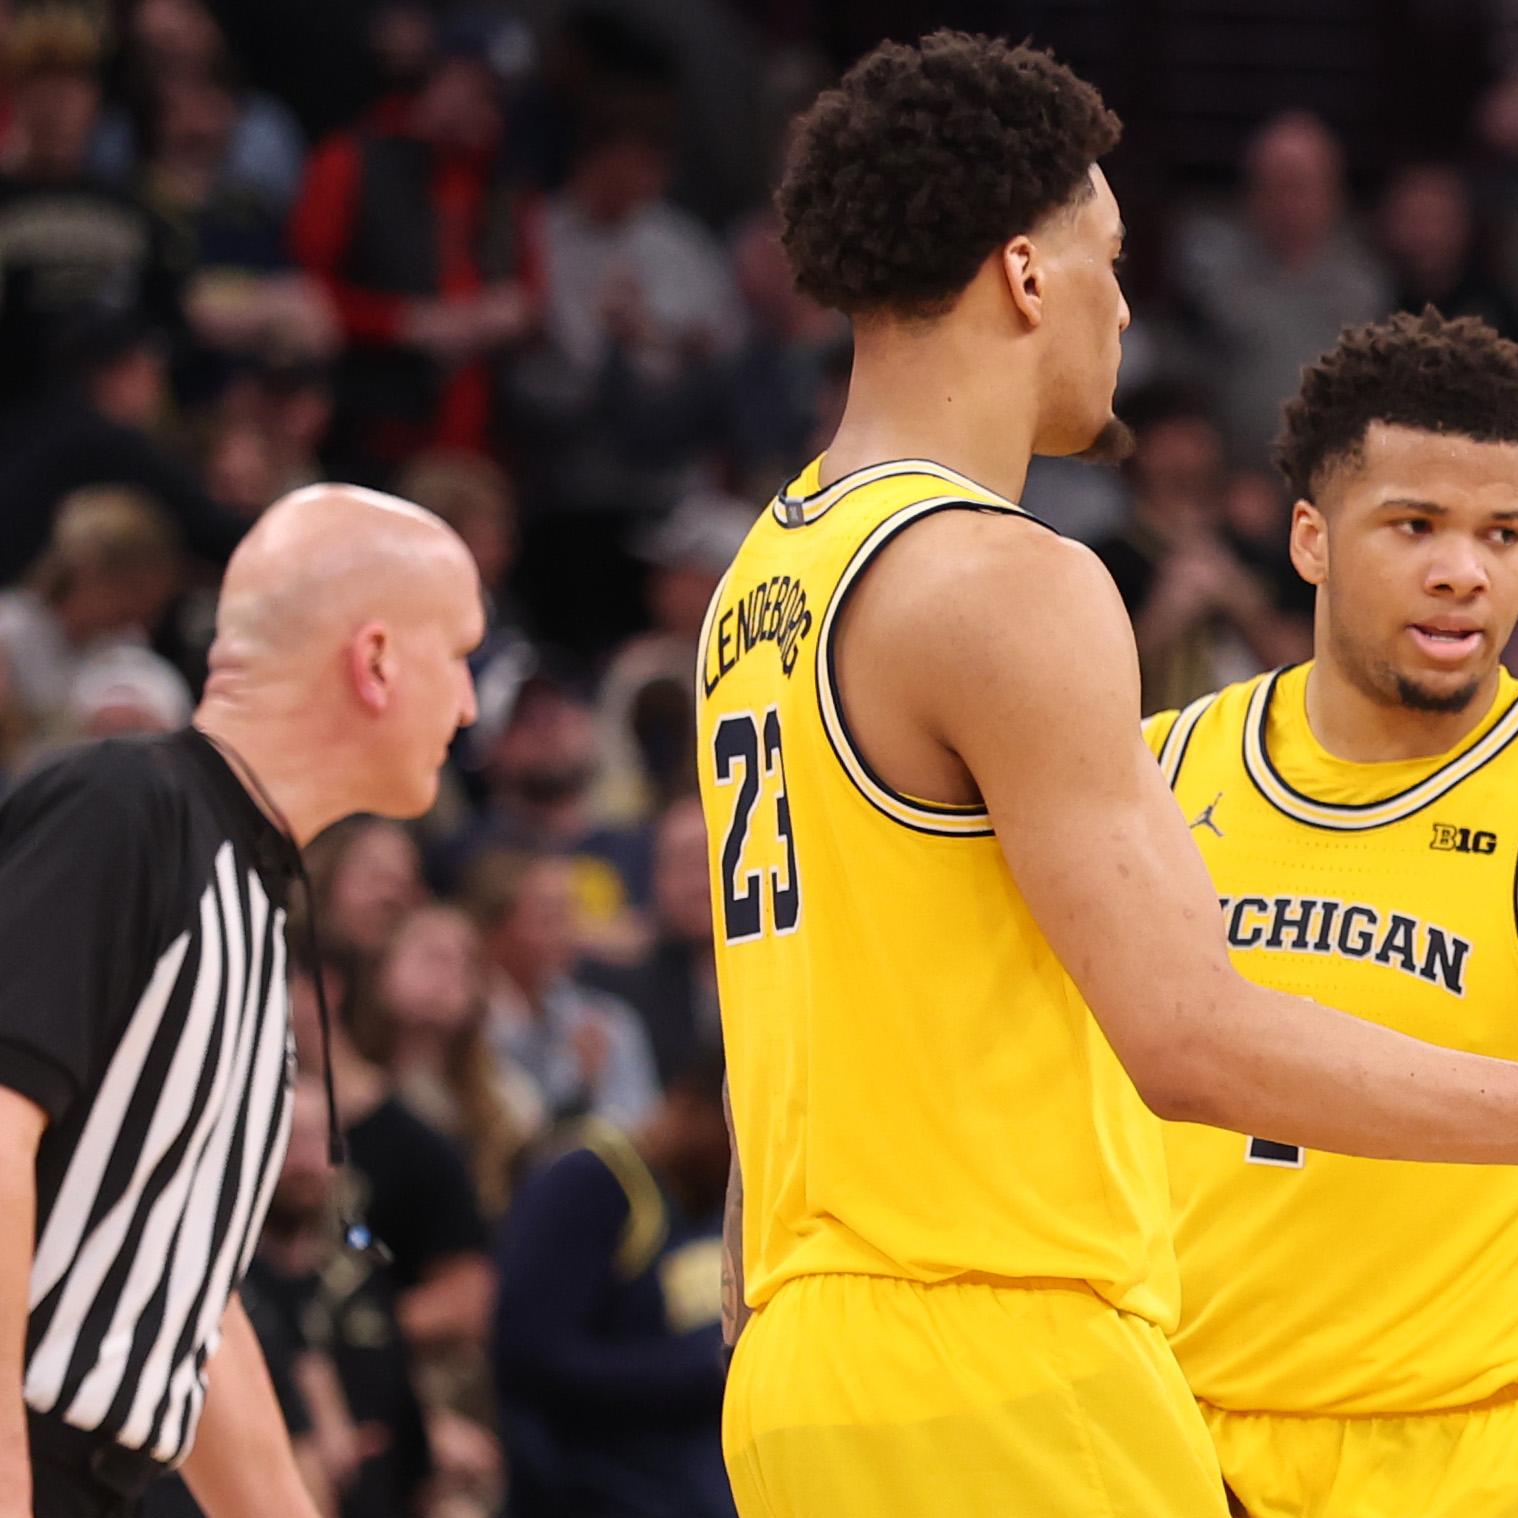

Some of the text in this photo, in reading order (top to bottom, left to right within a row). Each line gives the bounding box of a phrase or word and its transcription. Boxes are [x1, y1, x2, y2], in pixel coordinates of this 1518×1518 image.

[702, 576, 812, 700] LENDEBORG
[713, 703, 799, 946] 23
[1218, 896, 1470, 996] CHIGAN
